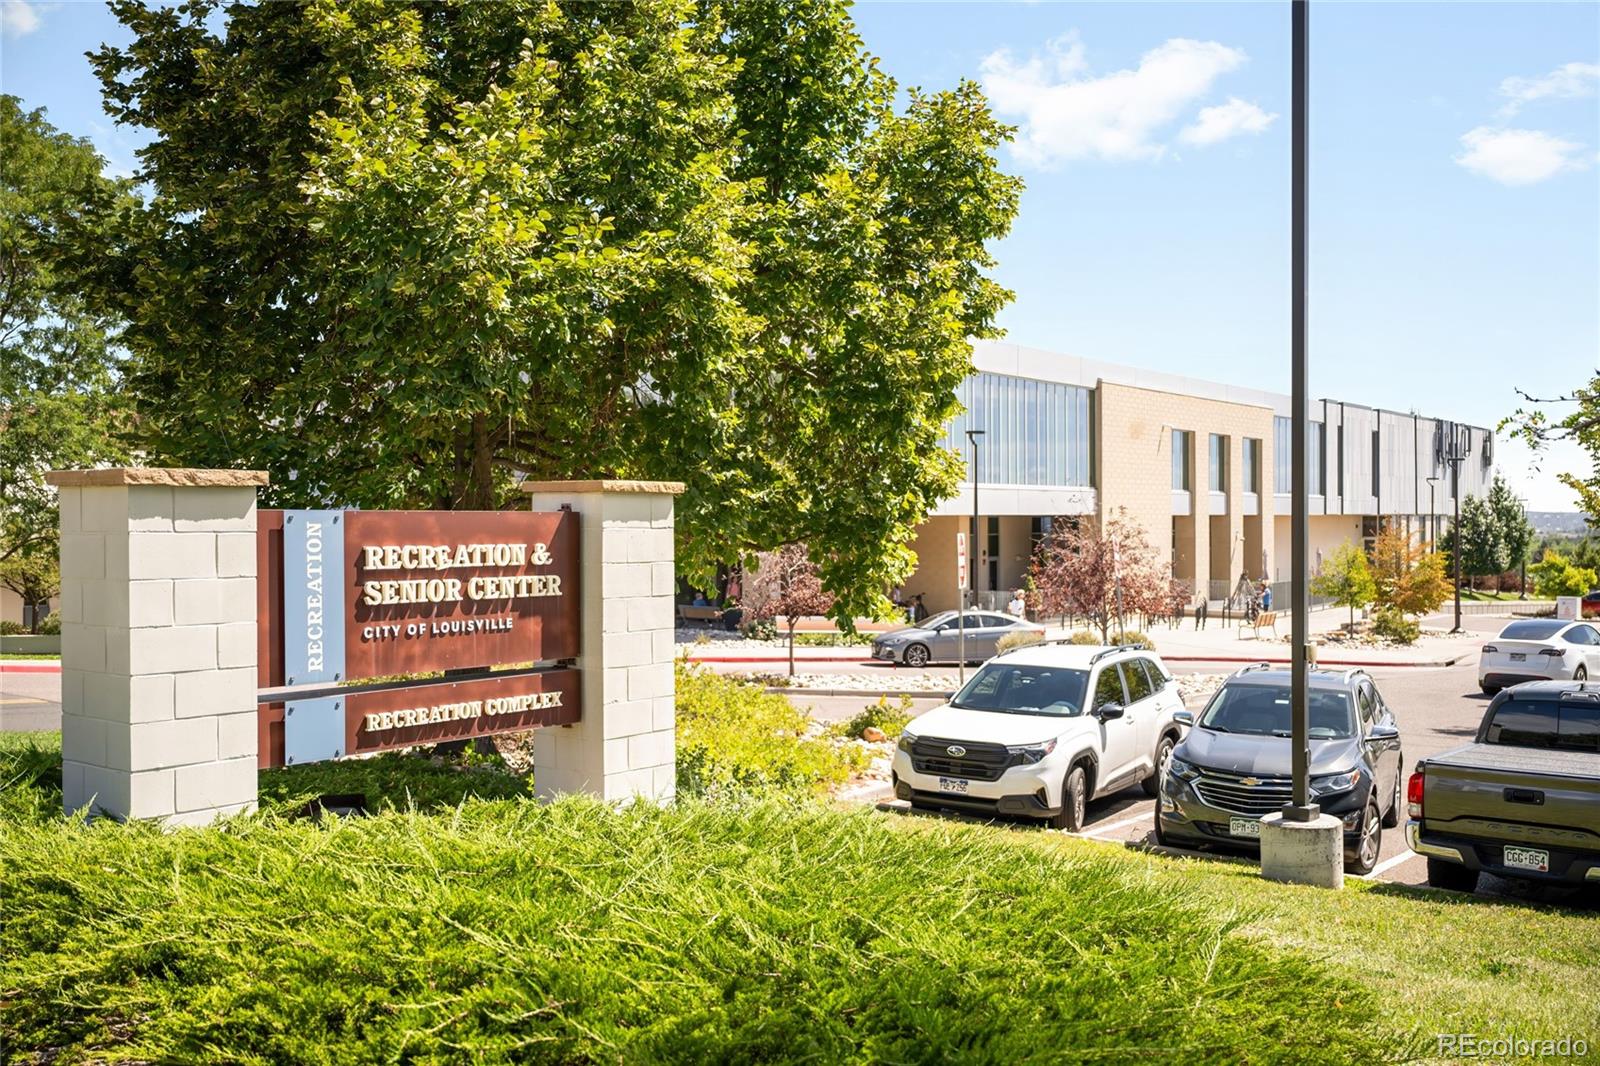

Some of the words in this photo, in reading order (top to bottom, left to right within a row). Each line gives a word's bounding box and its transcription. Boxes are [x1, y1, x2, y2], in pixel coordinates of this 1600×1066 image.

[363, 543, 527, 571] RECREATION
[530, 542, 553, 566] &
[307, 521, 323, 673] RECREATION
[363, 578, 463, 606] SENIOR
[467, 575, 563, 601] CENTER
[363, 623, 401, 639] CITY
[407, 621, 427, 637] OF
[432, 617, 514, 634] LOUISVILLE
[364, 701, 482, 732] RECREATION
[484, 691, 563, 717] COMPLEX
